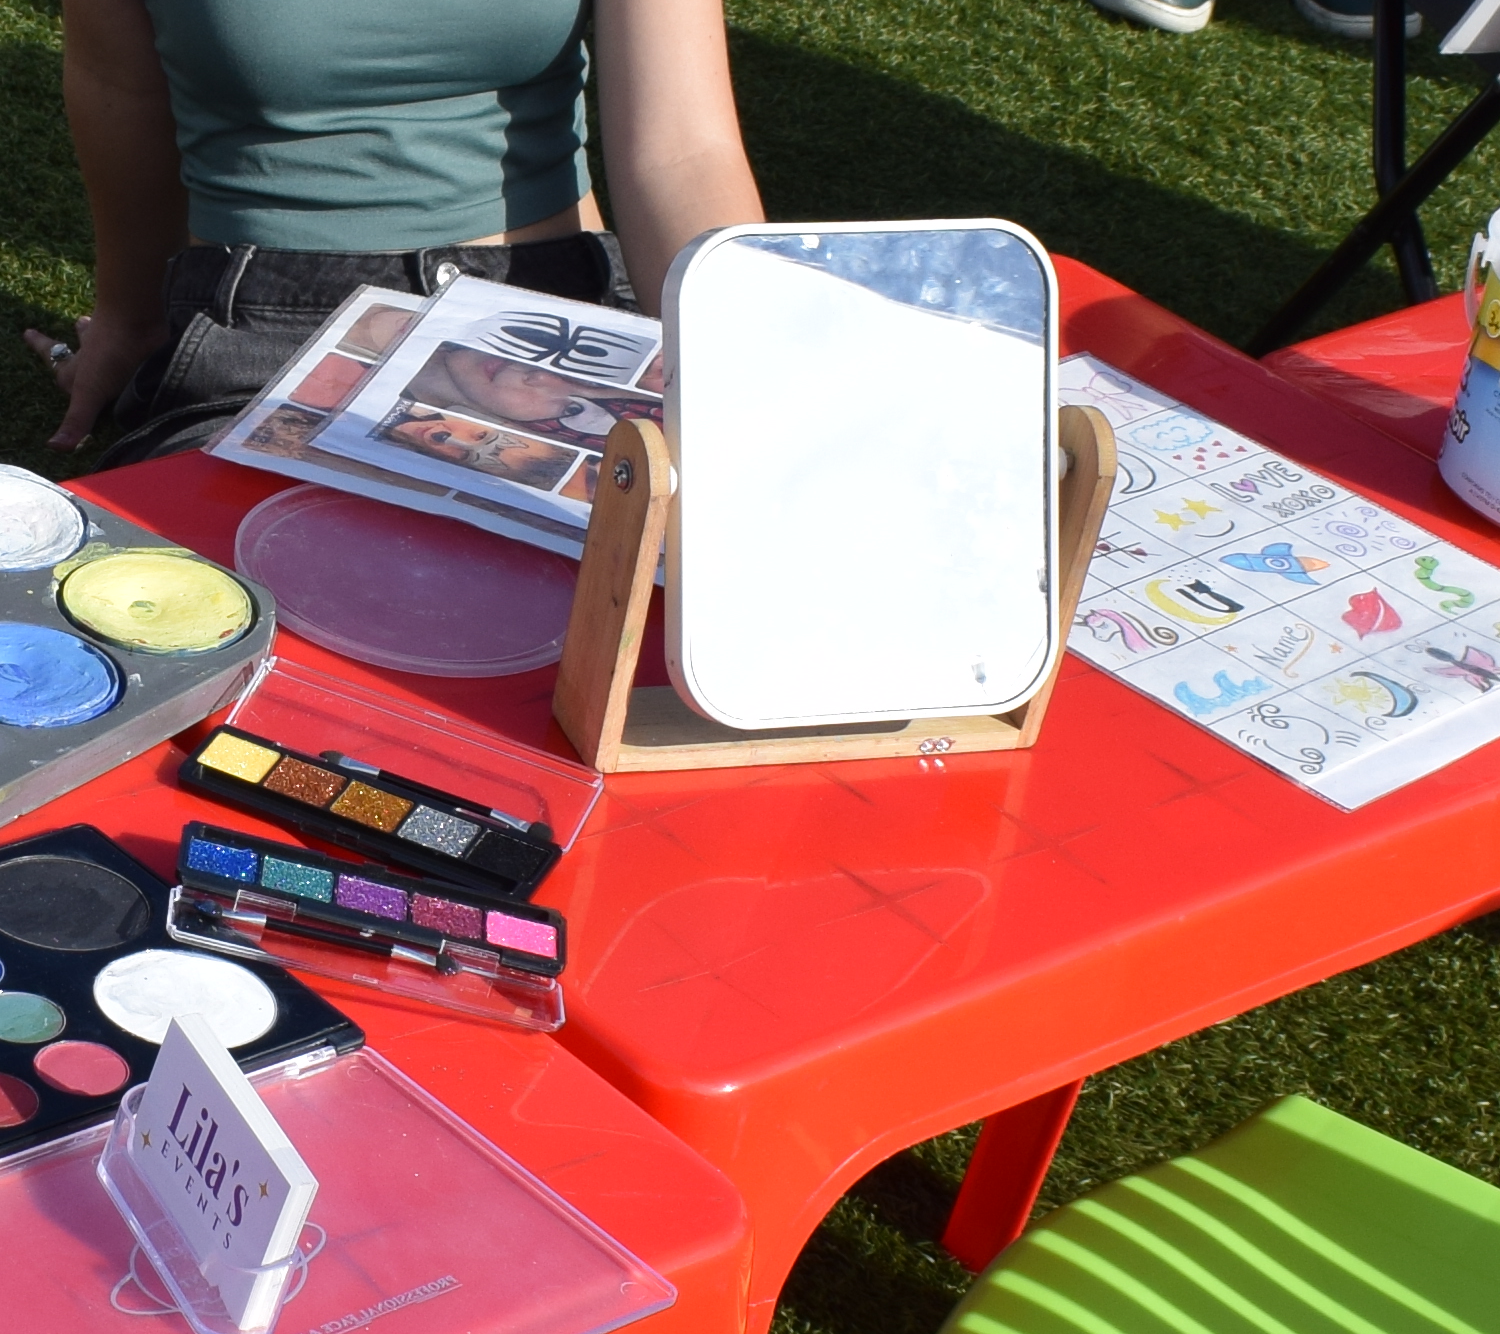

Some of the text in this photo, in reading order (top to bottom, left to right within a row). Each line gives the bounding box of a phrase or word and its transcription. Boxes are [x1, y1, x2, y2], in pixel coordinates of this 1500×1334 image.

[1262, 484, 1336, 519] XOXO
[1252, 624, 1308, 669] Name
[166, 1082, 250, 1227] Lila's
[161, 1139, 232, 1250] EVENTS
